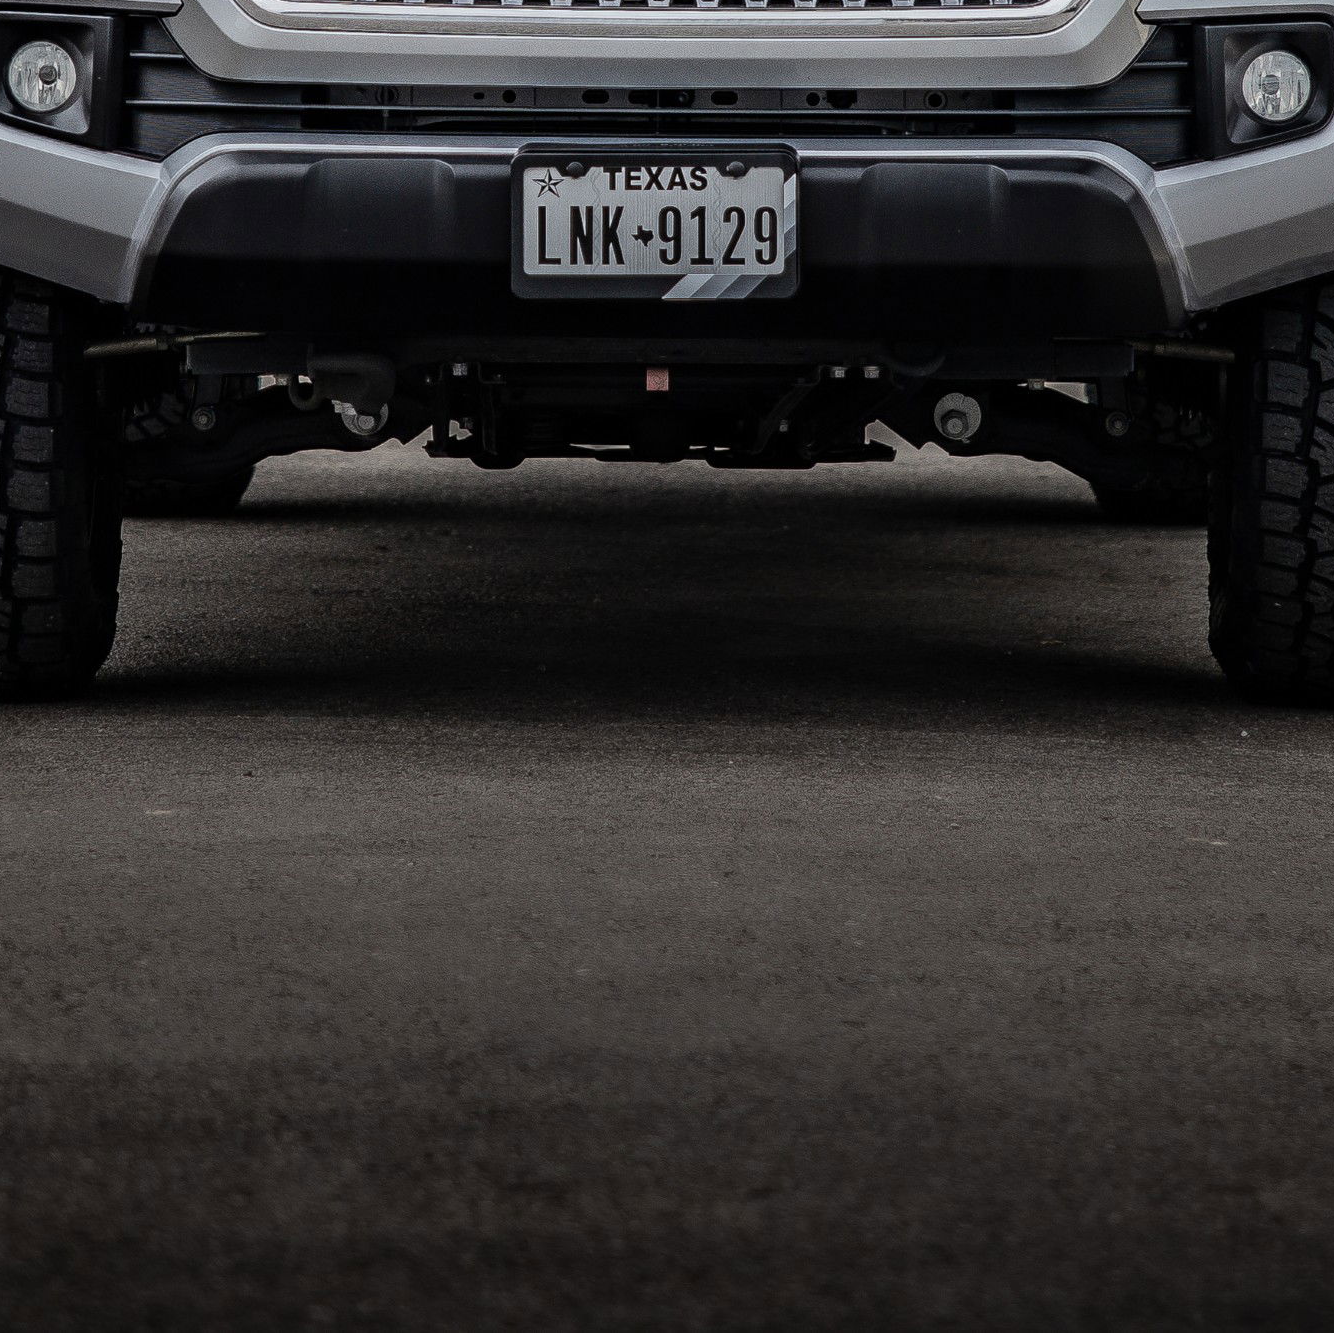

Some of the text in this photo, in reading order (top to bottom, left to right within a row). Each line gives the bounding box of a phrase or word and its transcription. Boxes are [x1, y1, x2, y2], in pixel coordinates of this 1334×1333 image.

[603, 166, 708, 191] TEXAS
[537, 205, 778, 266] LNK 9129
